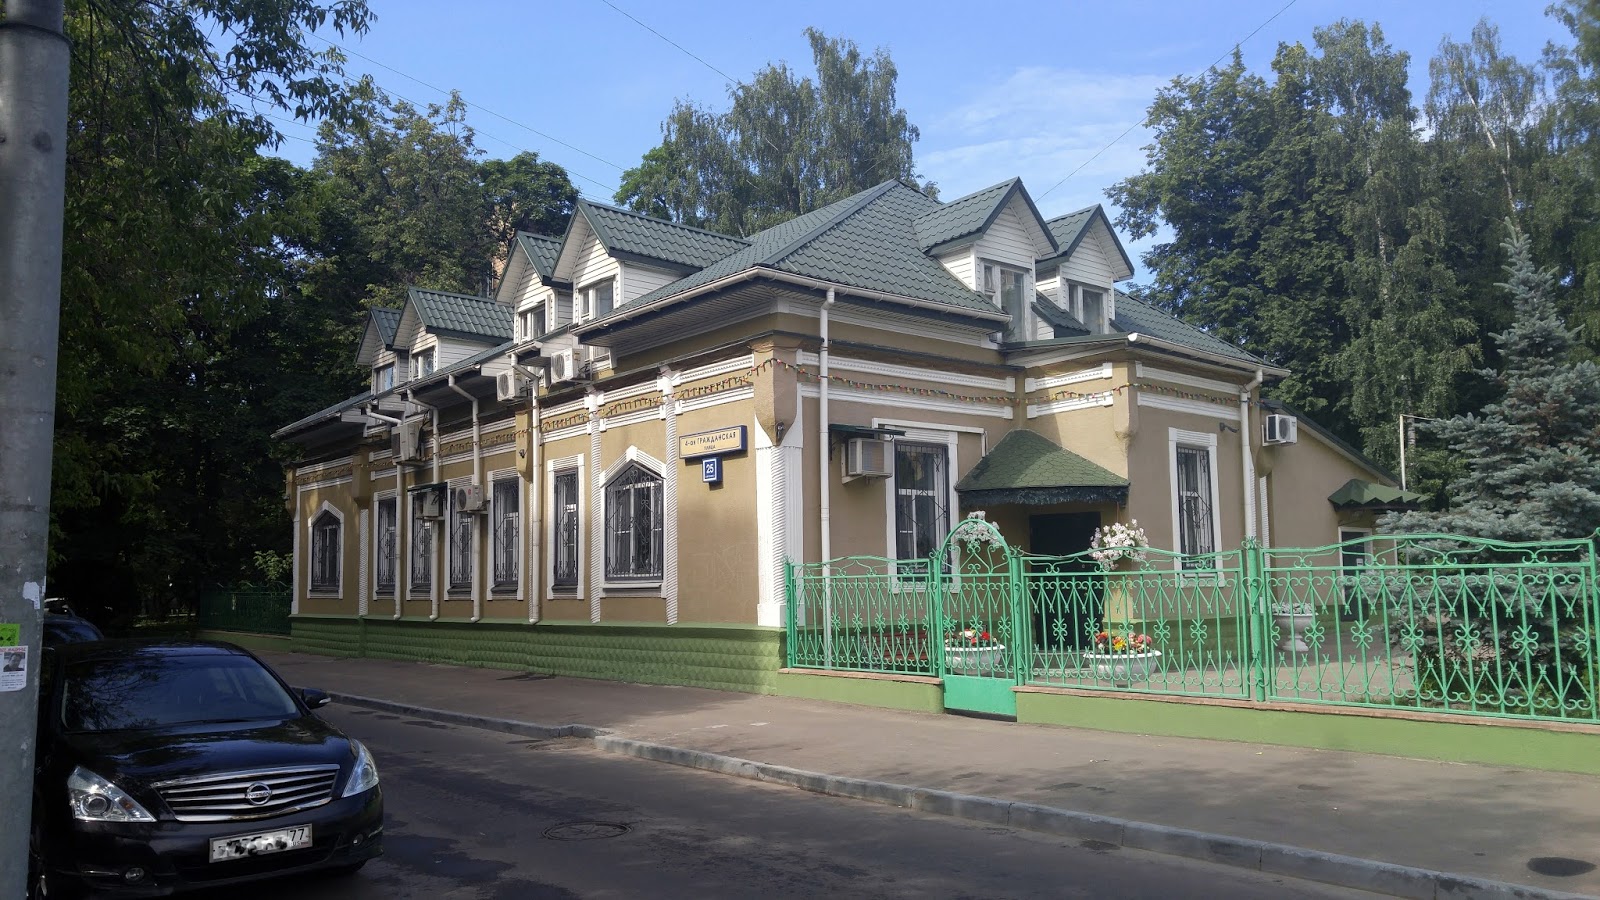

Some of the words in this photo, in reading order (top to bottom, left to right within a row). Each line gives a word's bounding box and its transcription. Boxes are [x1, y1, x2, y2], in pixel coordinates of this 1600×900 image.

[697, 431, 736, 444] ГРАЖДАНСКАЯ
[706, 463, 714, 474] 25
[290, 828, 304, 842] 77
